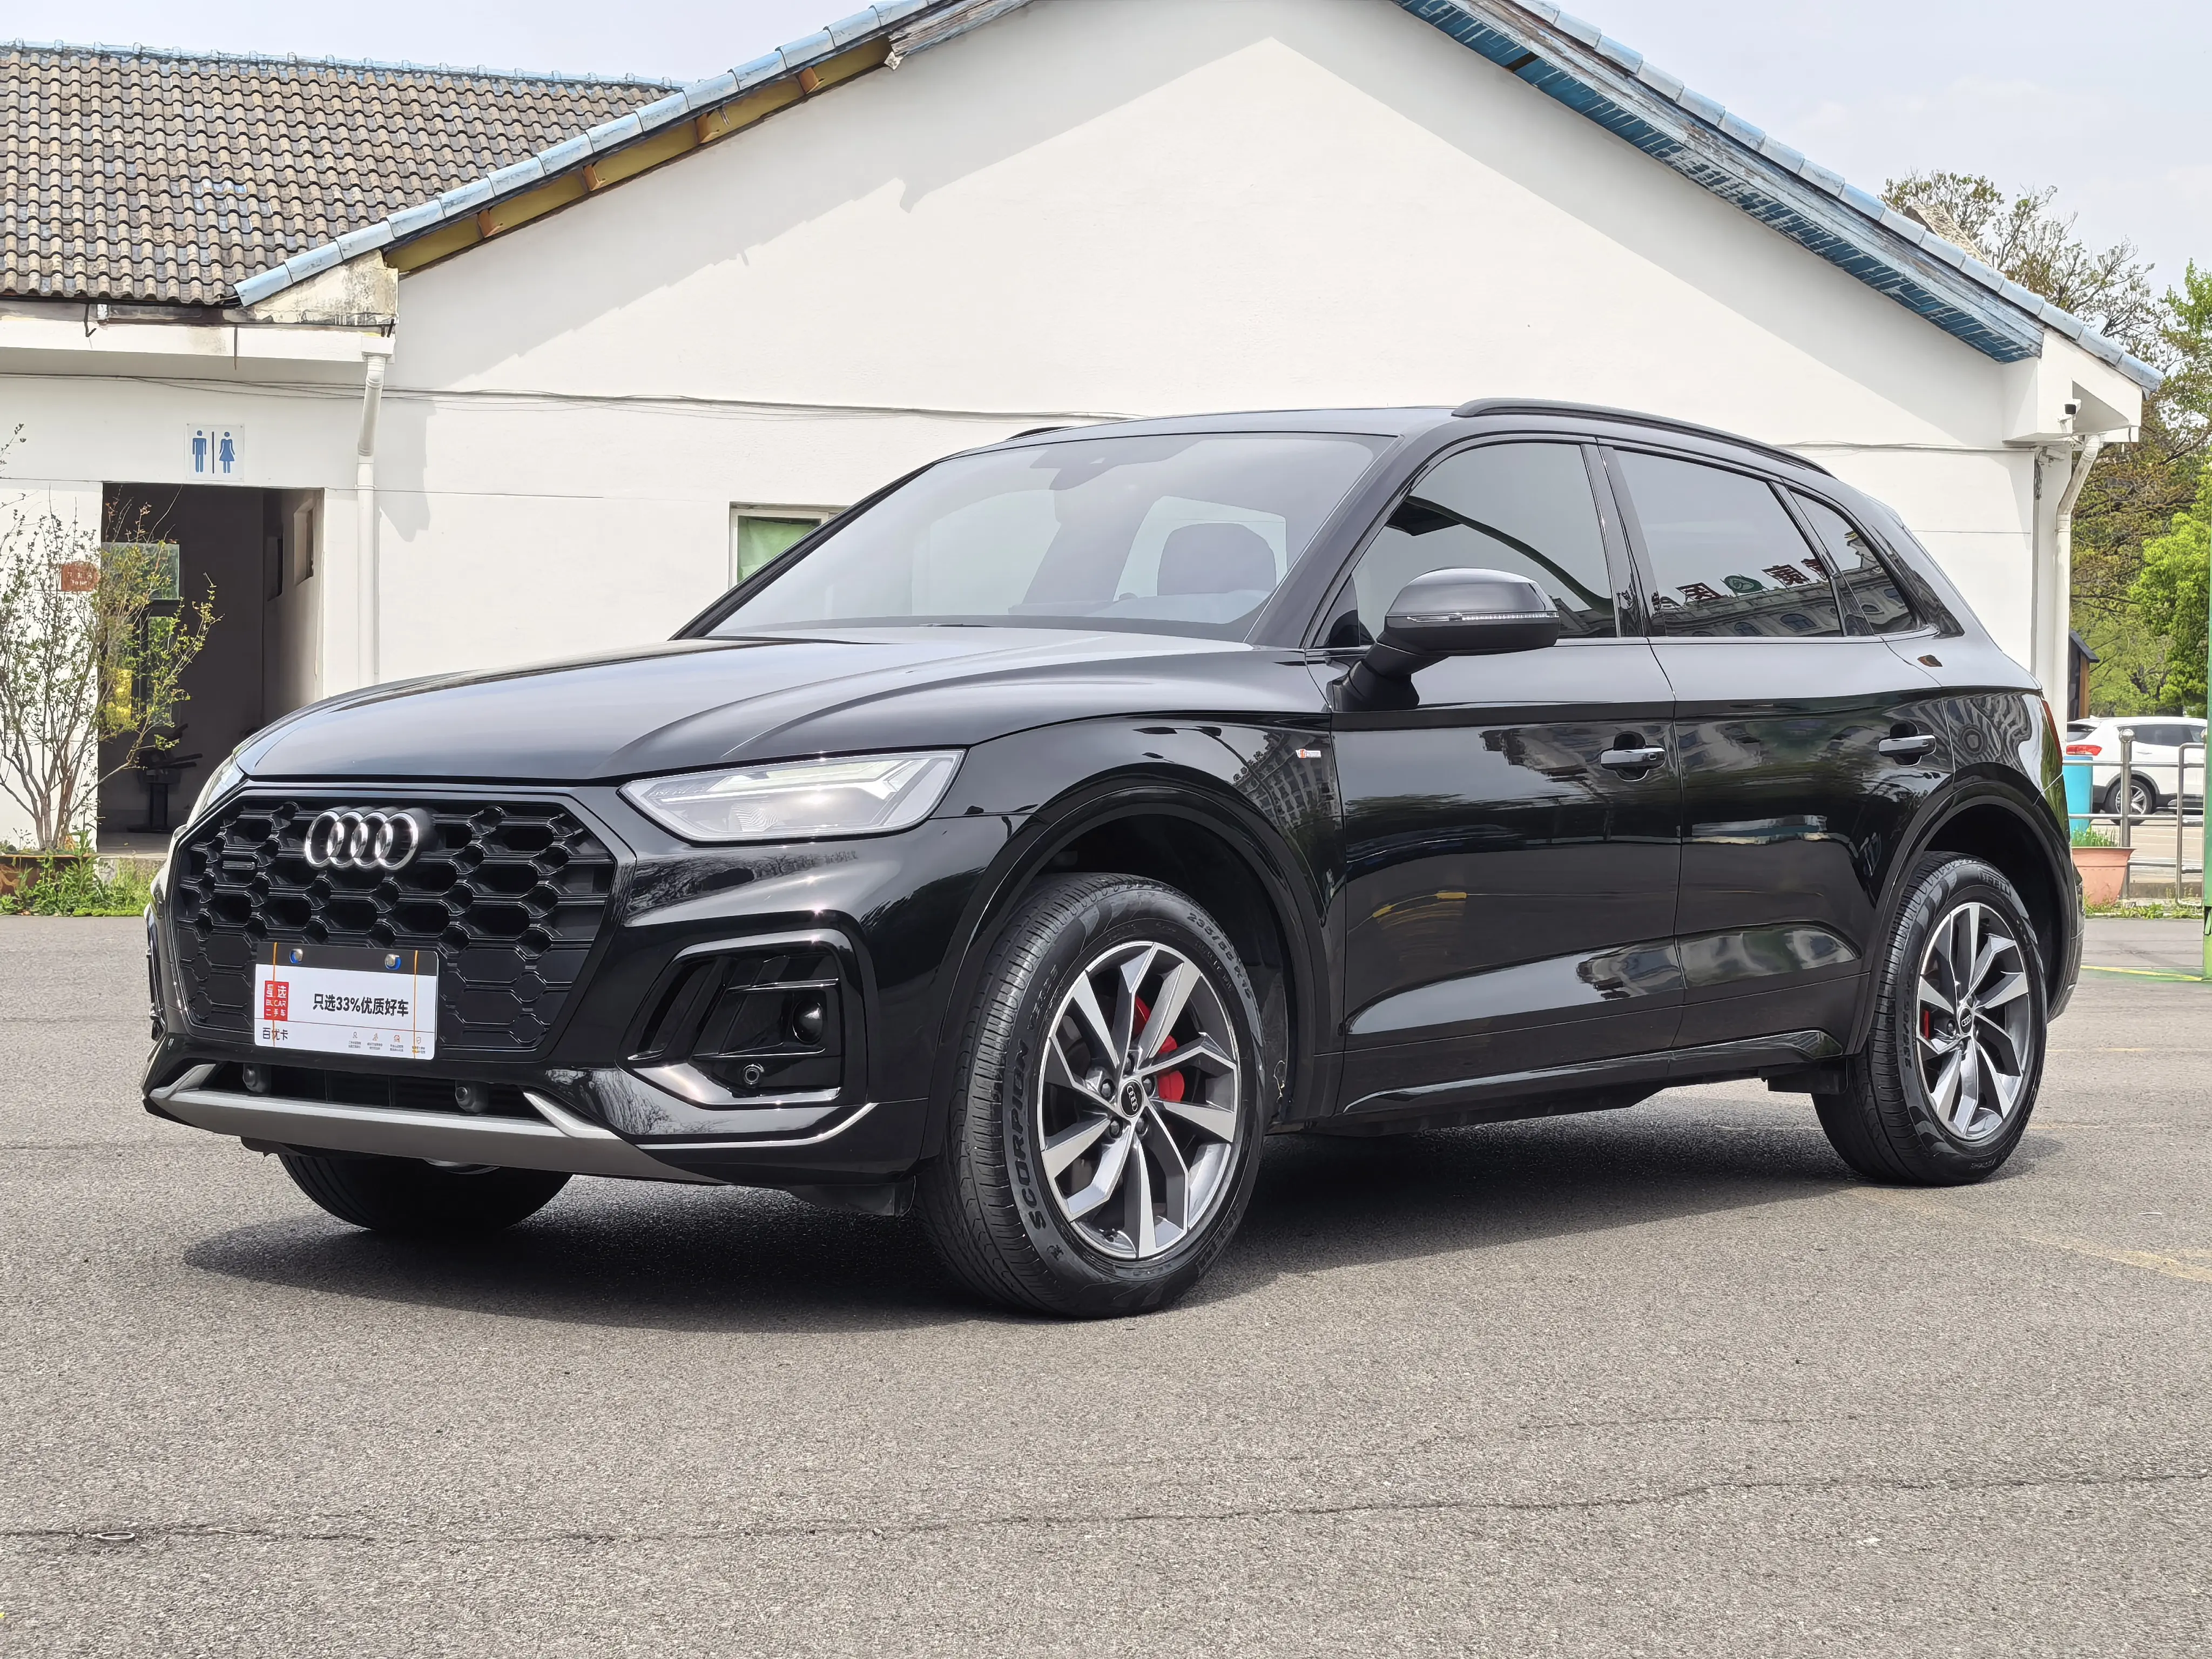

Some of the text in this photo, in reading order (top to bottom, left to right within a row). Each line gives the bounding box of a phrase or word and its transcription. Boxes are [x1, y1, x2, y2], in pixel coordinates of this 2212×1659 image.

[313, 993, 409, 1017] 只选33%优质好车
[262, 1027, 288, 1041] 百优卡
[1010, 1038, 1047, 1230] SCORPION
